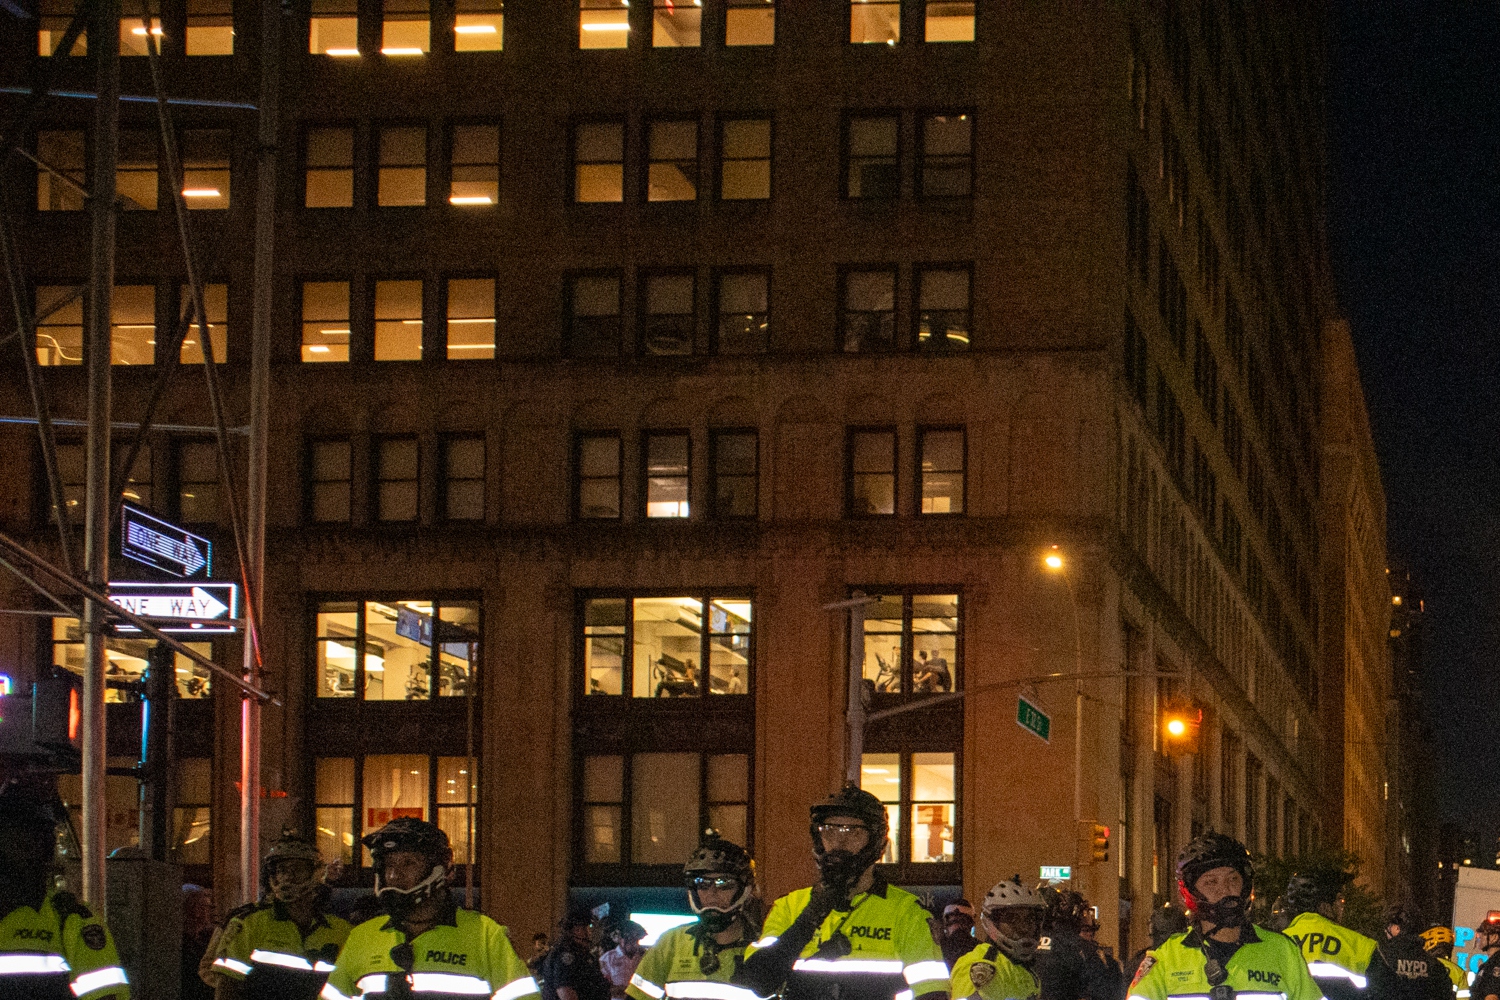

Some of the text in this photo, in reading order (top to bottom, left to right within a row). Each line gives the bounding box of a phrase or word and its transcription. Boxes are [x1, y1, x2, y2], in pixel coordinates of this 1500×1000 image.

[138, 528, 160, 552] ONE
[173, 541, 203, 562] WAY
[170, 599, 211, 616] WAY
[1041, 867, 1060, 877] PARK
[850, 925, 892, 941] POLICE
[1293, 932, 1342, 956] YPD
[425, 950, 467, 966] POLICE
[1397, 959, 1428, 973] NYPD
[1247, 969, 1282, 987] POLICE
